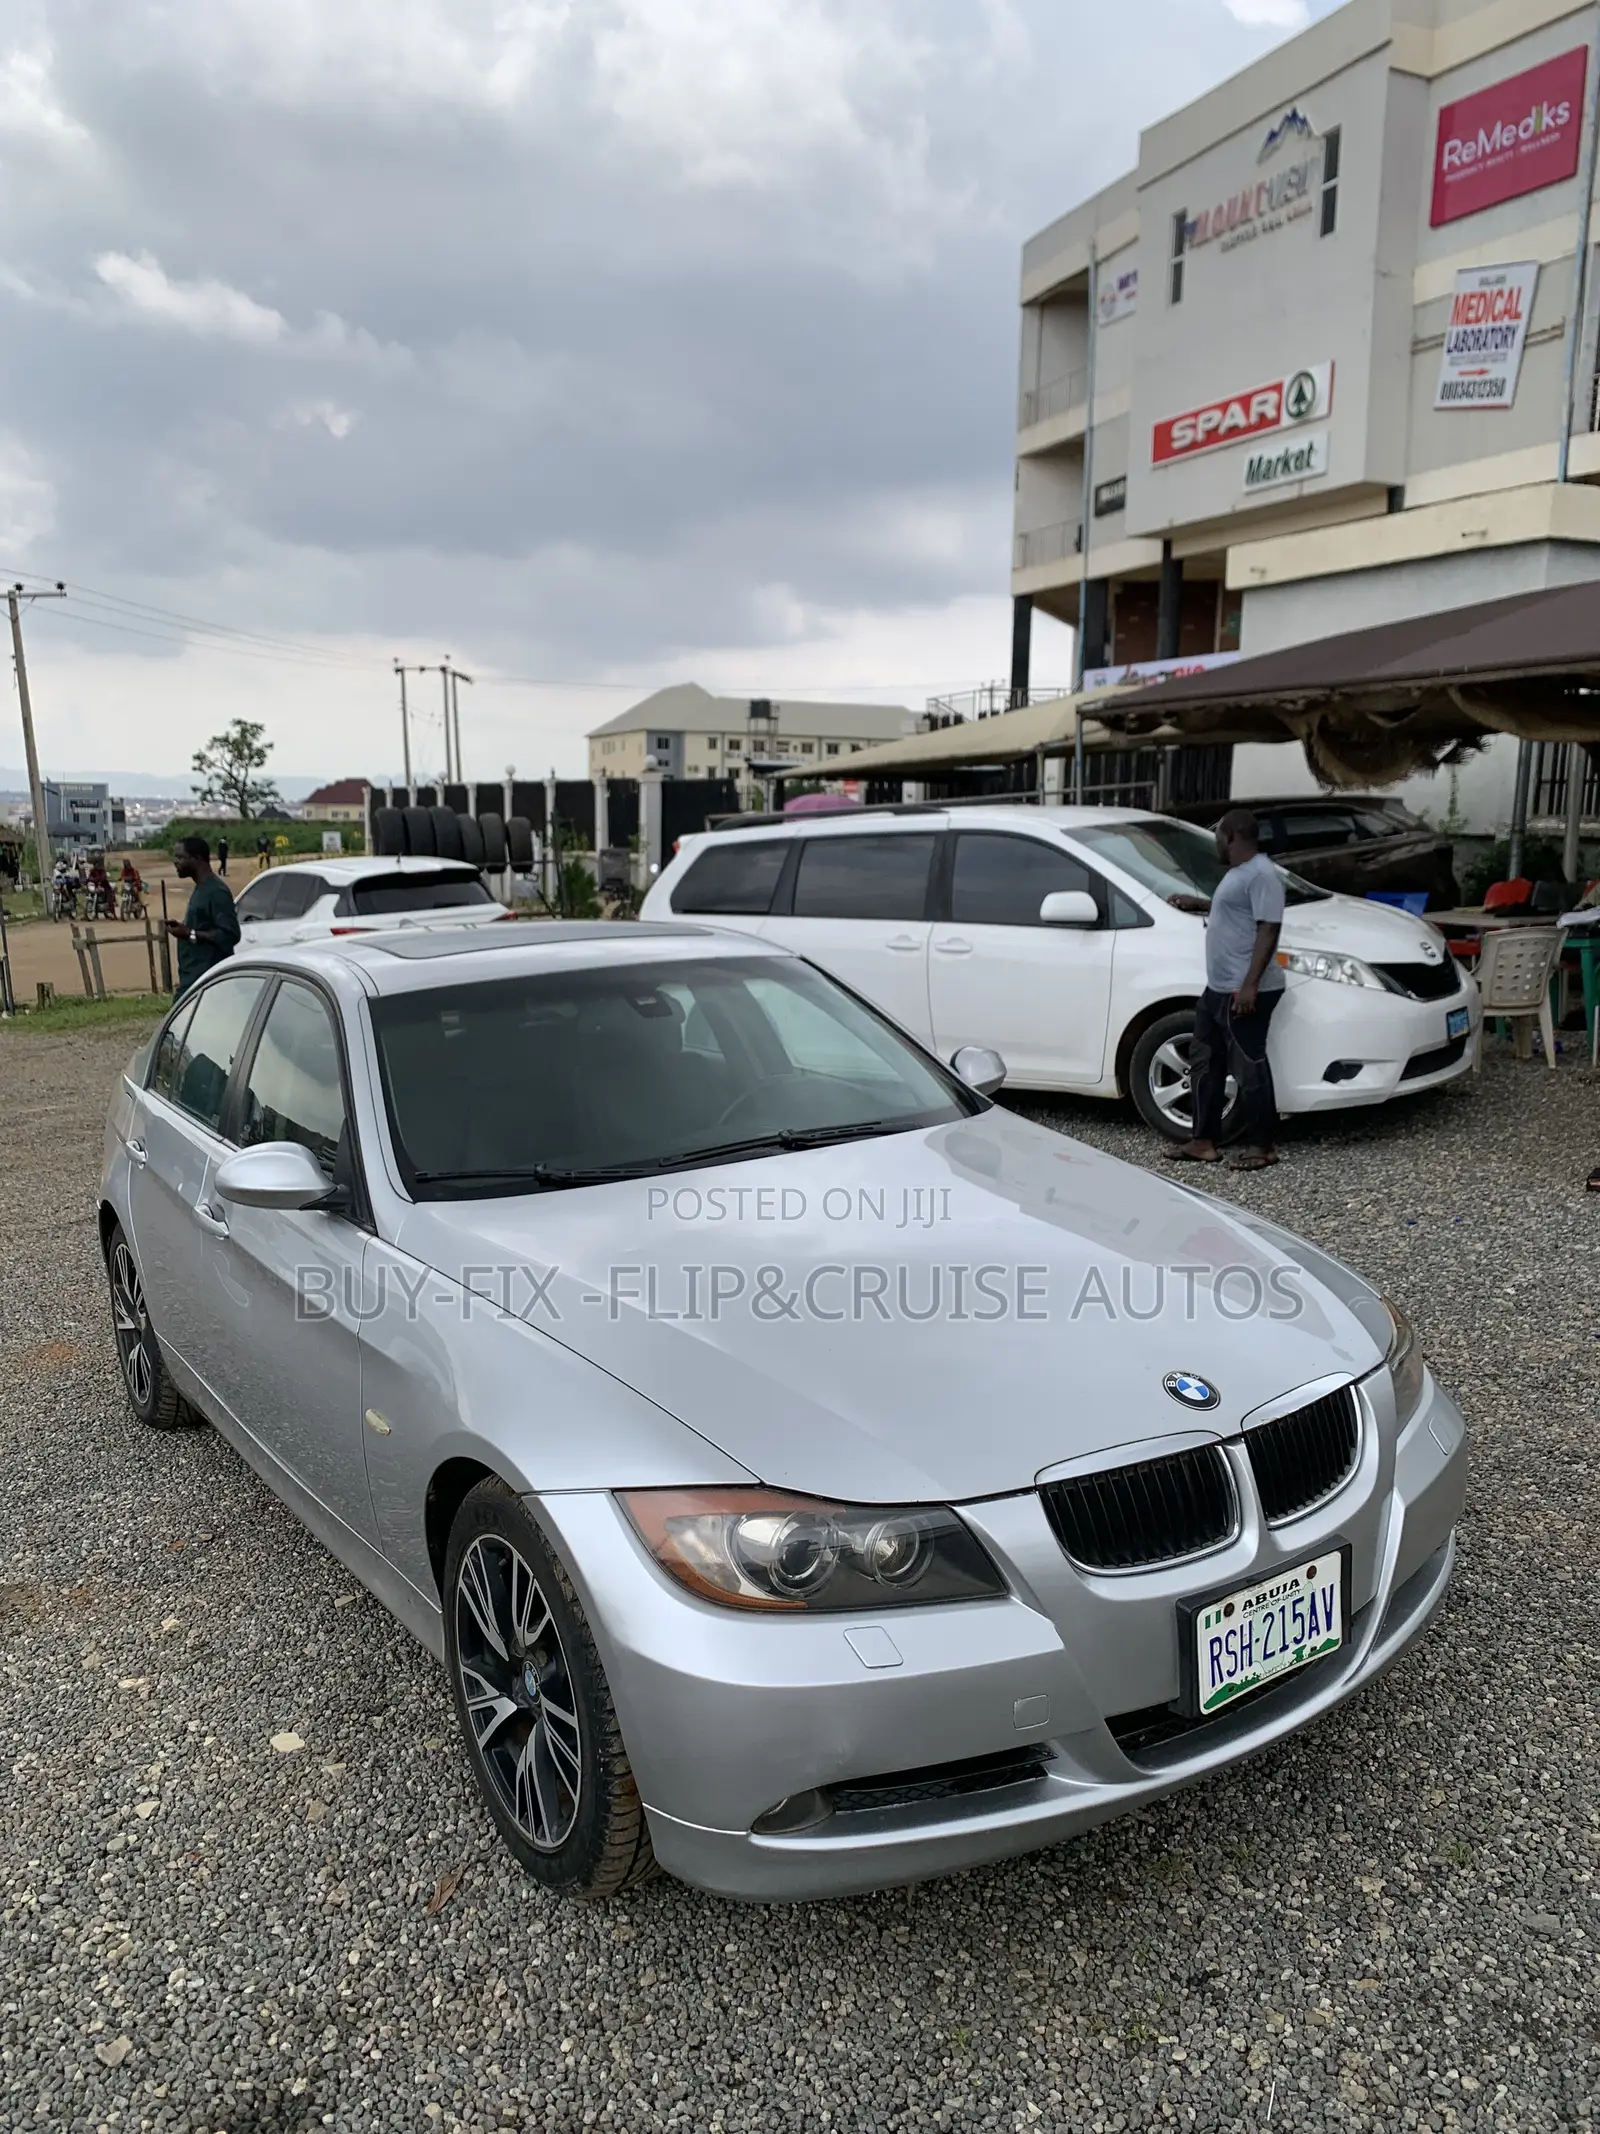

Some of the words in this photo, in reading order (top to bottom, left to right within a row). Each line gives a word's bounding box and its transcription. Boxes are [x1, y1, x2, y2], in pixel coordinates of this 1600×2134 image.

[1443, 101, 1571, 172] ReMediks
[1451, 286, 1523, 326] MEDICAL
[1447, 324, 1519, 353] LABORATORY
[1170, 390, 1281, 450] SPAR
[1245, 440, 1318, 486] Market
[1242, 1578, 1300, 1611] ABUJA
[1243, 1603, 1270, 1618] CENTRE
[1271, 1598, 1281, 1606] OF
[1282, 1589, 1301, 1601] UNITY
